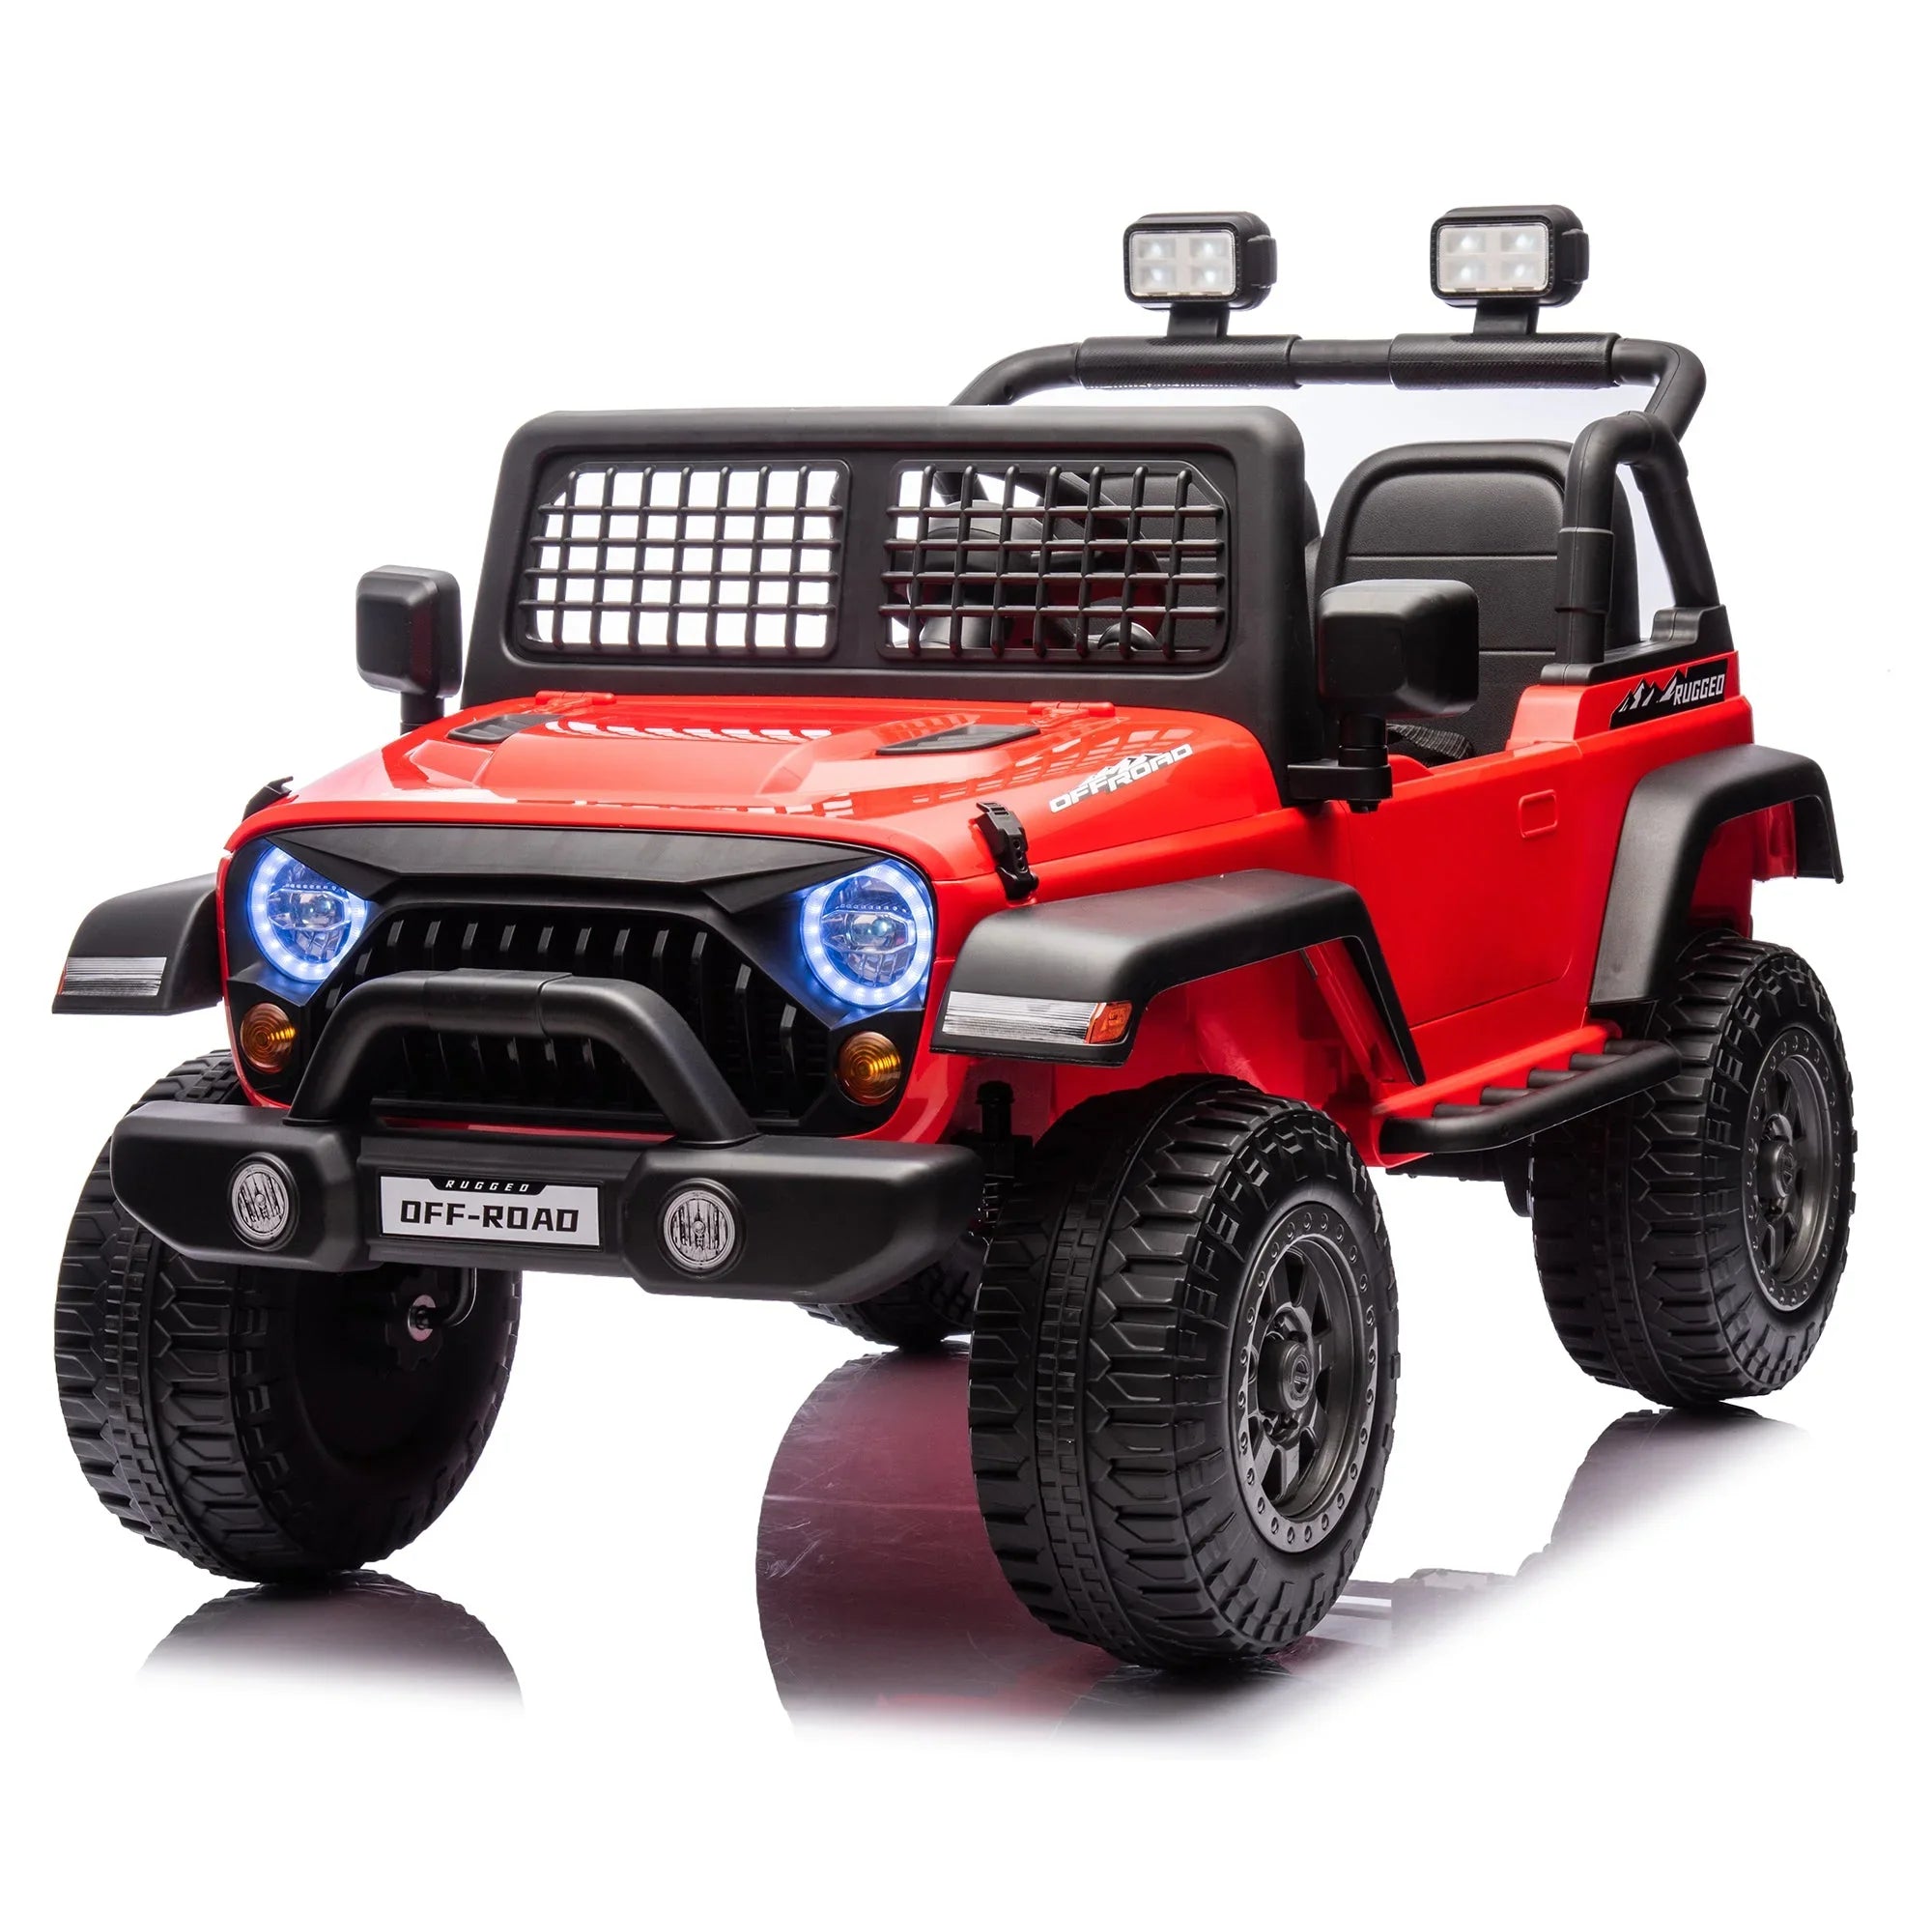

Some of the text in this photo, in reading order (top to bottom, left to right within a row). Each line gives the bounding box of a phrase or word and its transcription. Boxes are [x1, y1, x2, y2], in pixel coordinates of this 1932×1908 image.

[1673, 673, 1725, 706] RUGGED
[1049, 744, 1193, 813] OFFROAD
[444, 1180, 529, 1193] RUGGED
[400, 1200, 580, 1233] OFF-ROAD
